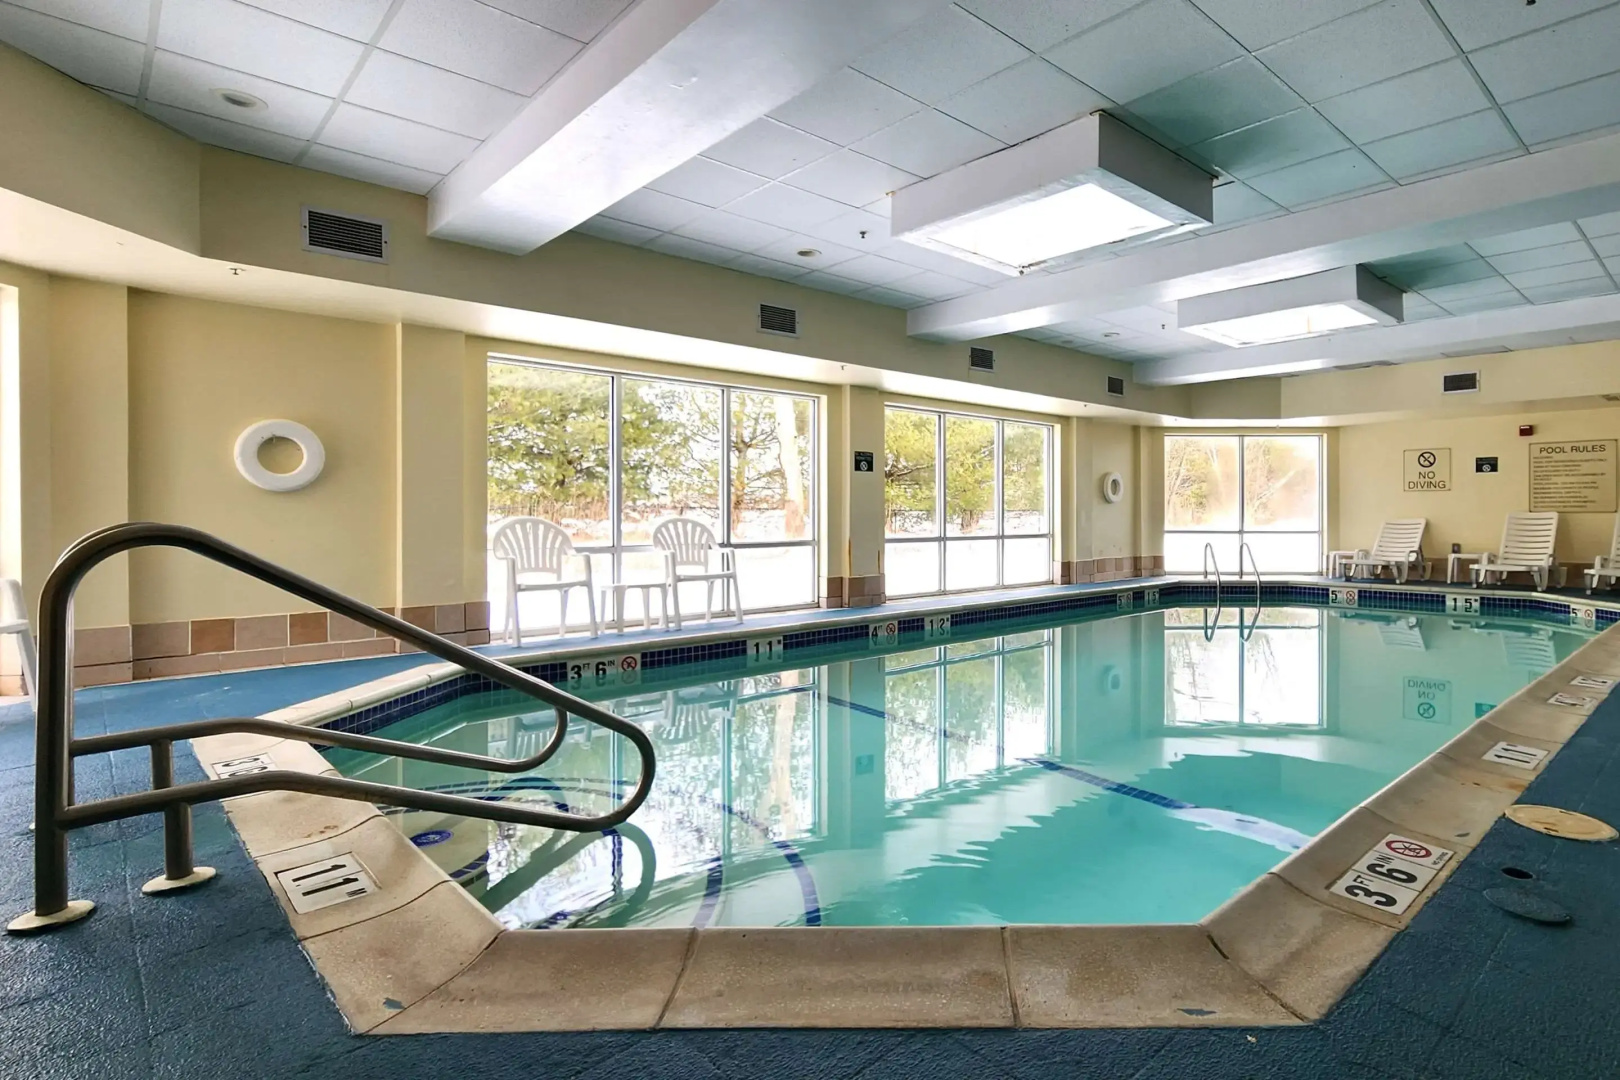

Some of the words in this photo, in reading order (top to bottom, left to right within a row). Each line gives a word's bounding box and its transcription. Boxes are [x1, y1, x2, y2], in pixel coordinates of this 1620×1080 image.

[1540, 446, 1567, 454] POOL
[1570, 444, 1606, 453] RULES
[1418, 471, 1436, 480] NO
[1408, 480, 1446, 489] DIVING
